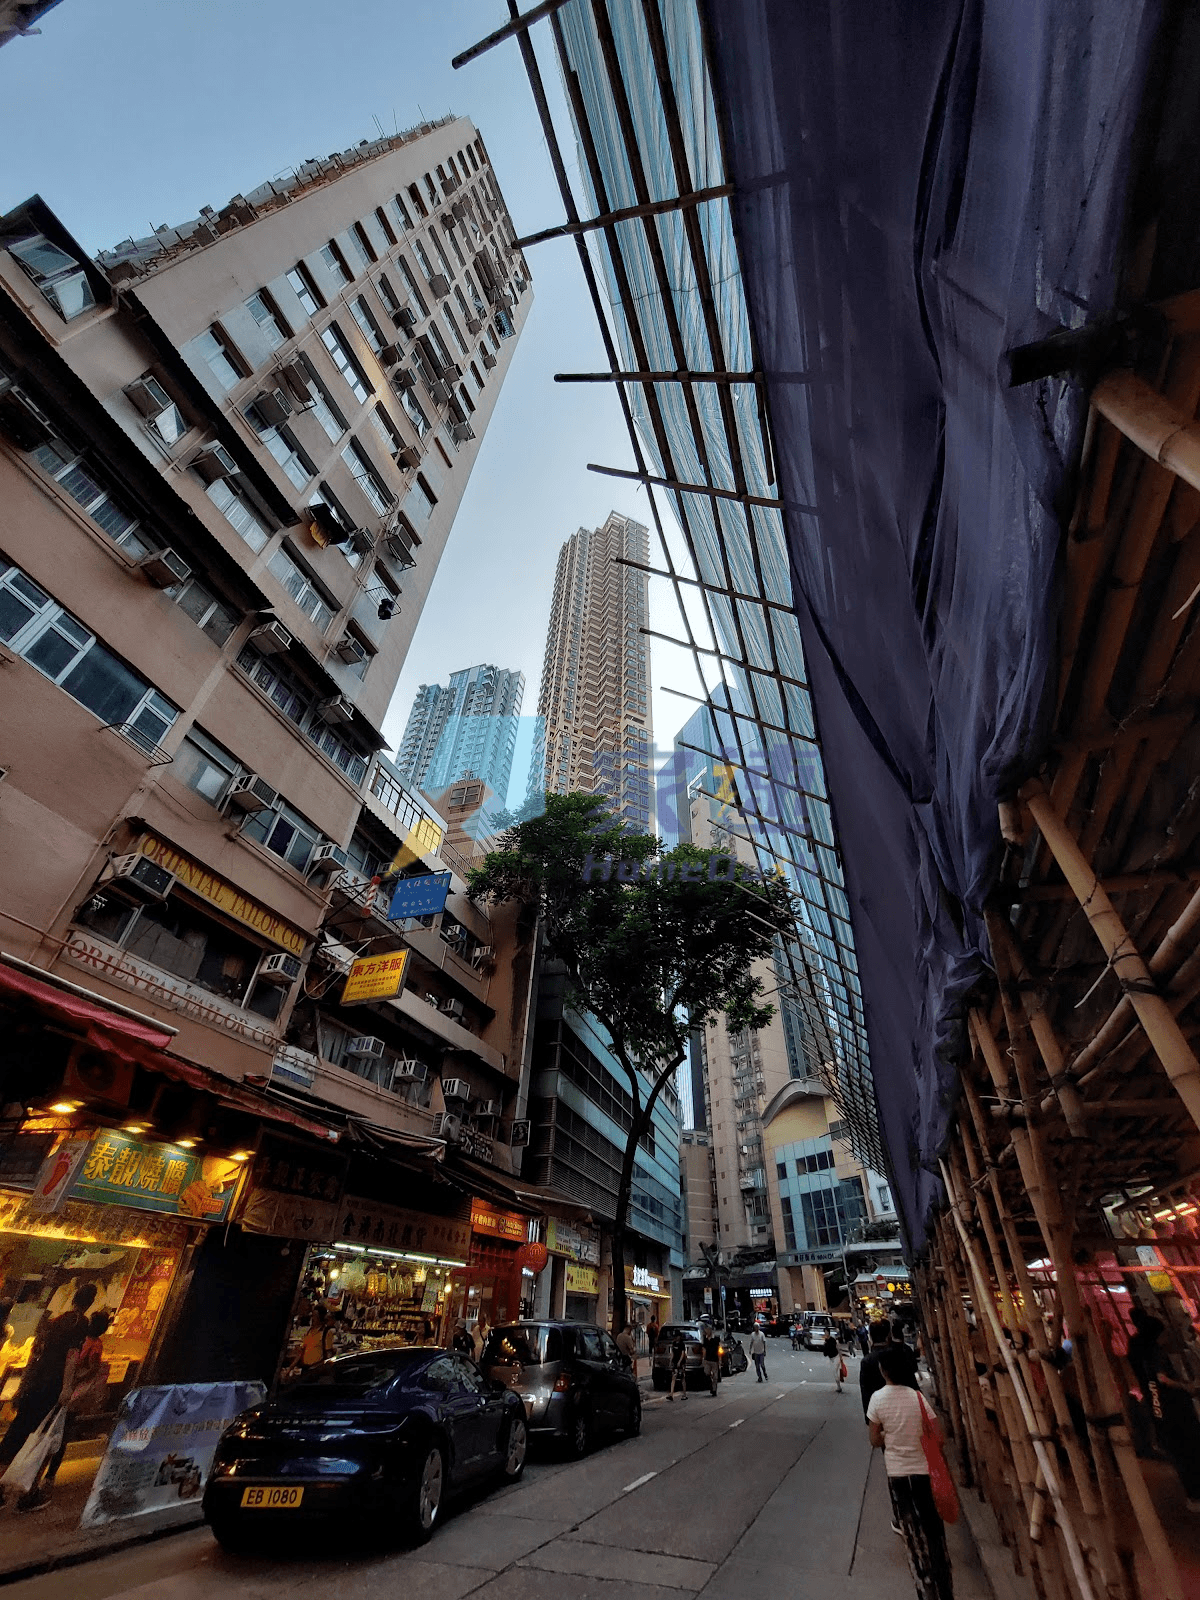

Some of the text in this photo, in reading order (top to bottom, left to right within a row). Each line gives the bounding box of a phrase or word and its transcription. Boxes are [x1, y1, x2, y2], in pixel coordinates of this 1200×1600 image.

[141, 837, 224, 903] ORIENTAL
[229, 894, 280, 938] TAILOR
[71, 939, 179, 1003] ORIENTAL
[183, 991, 248, 1036] TAILOR
[352, 957, 403, 977] 東方洋服
[83, 1141, 189, 1196] 泰靚燒臘
[246, 1489, 298, 1504] EB 1080
